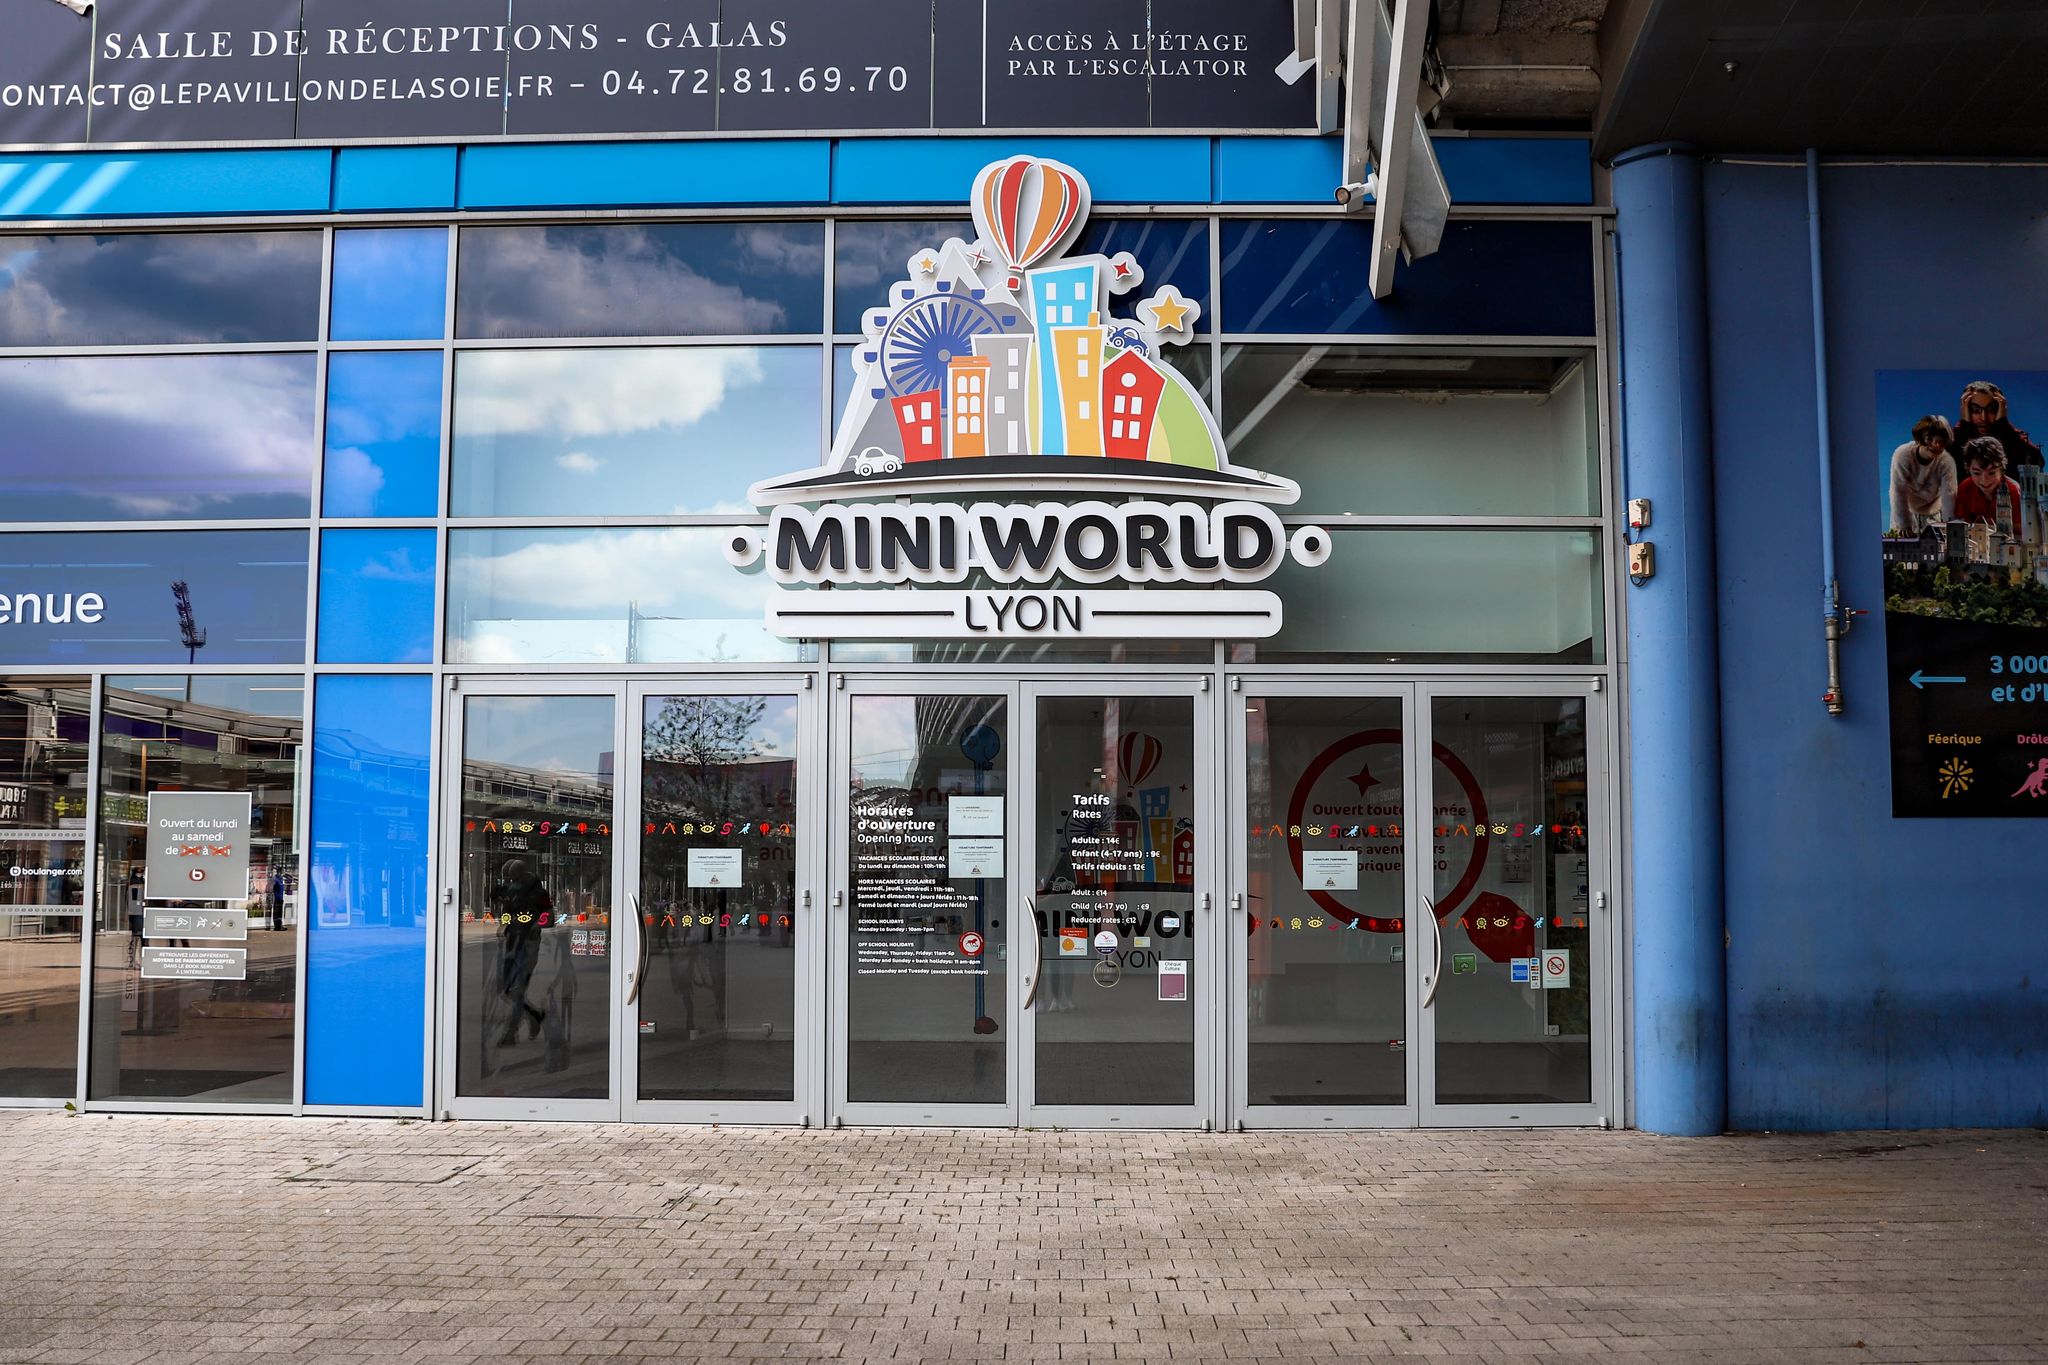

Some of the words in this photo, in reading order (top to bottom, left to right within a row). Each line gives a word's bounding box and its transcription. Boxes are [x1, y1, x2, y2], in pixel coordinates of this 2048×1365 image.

[103, 30, 233, 60] SALLE
[250, 29, 308, 57] DE
[326, 21, 599, 55] RÉCEPTIONS
[646, 19, 788, 50] GALAS
[1008, 30, 1093, 51] ACCÈS
[1104, 30, 1120, 50] À
[1131, 30, 1248, 51] L'ÉTAGE
[1007, 59, 1056, 76] PAR
[1067, 59, 1248, 76] L'ESCALATOR
[601, 65, 908, 98] 04.72.81.69.70
[776, 515, 956, 571] MINI
[979, 514, 1275, 571] WORLD
[0, 591, 104, 624] enue
[964, 595, 1082, 632] LYON
[1990, 655, 2004, 674] 3
[1991, 683, 2015, 702] et
[1928, 733, 1982, 746] Féerique
[1072, 794, 1110, 805] Tarifs
[857, 805, 913, 816] Horaires
[1072, 810, 1102, 819] Rates
[1312, 804, 1365, 816] Ouvert
[160, 818, 194, 828] Ouvert
[197, 818, 210, 828] du
[213, 818, 238, 828] lundi
[857, 819, 935, 830] d'ouverture
[172, 833, 184, 841] au
[187, 832, 224, 842] samedi
[857, 833, 902, 844] Opening
[904, 833, 934, 843] hours
[165, 846, 178, 855] de
[202, 846, 209, 855] à
[1100, 850, 1122, 858] (4-17
[1124, 850, 1142, 858] ans)
[22, 868, 82, 876] boulanger.com
